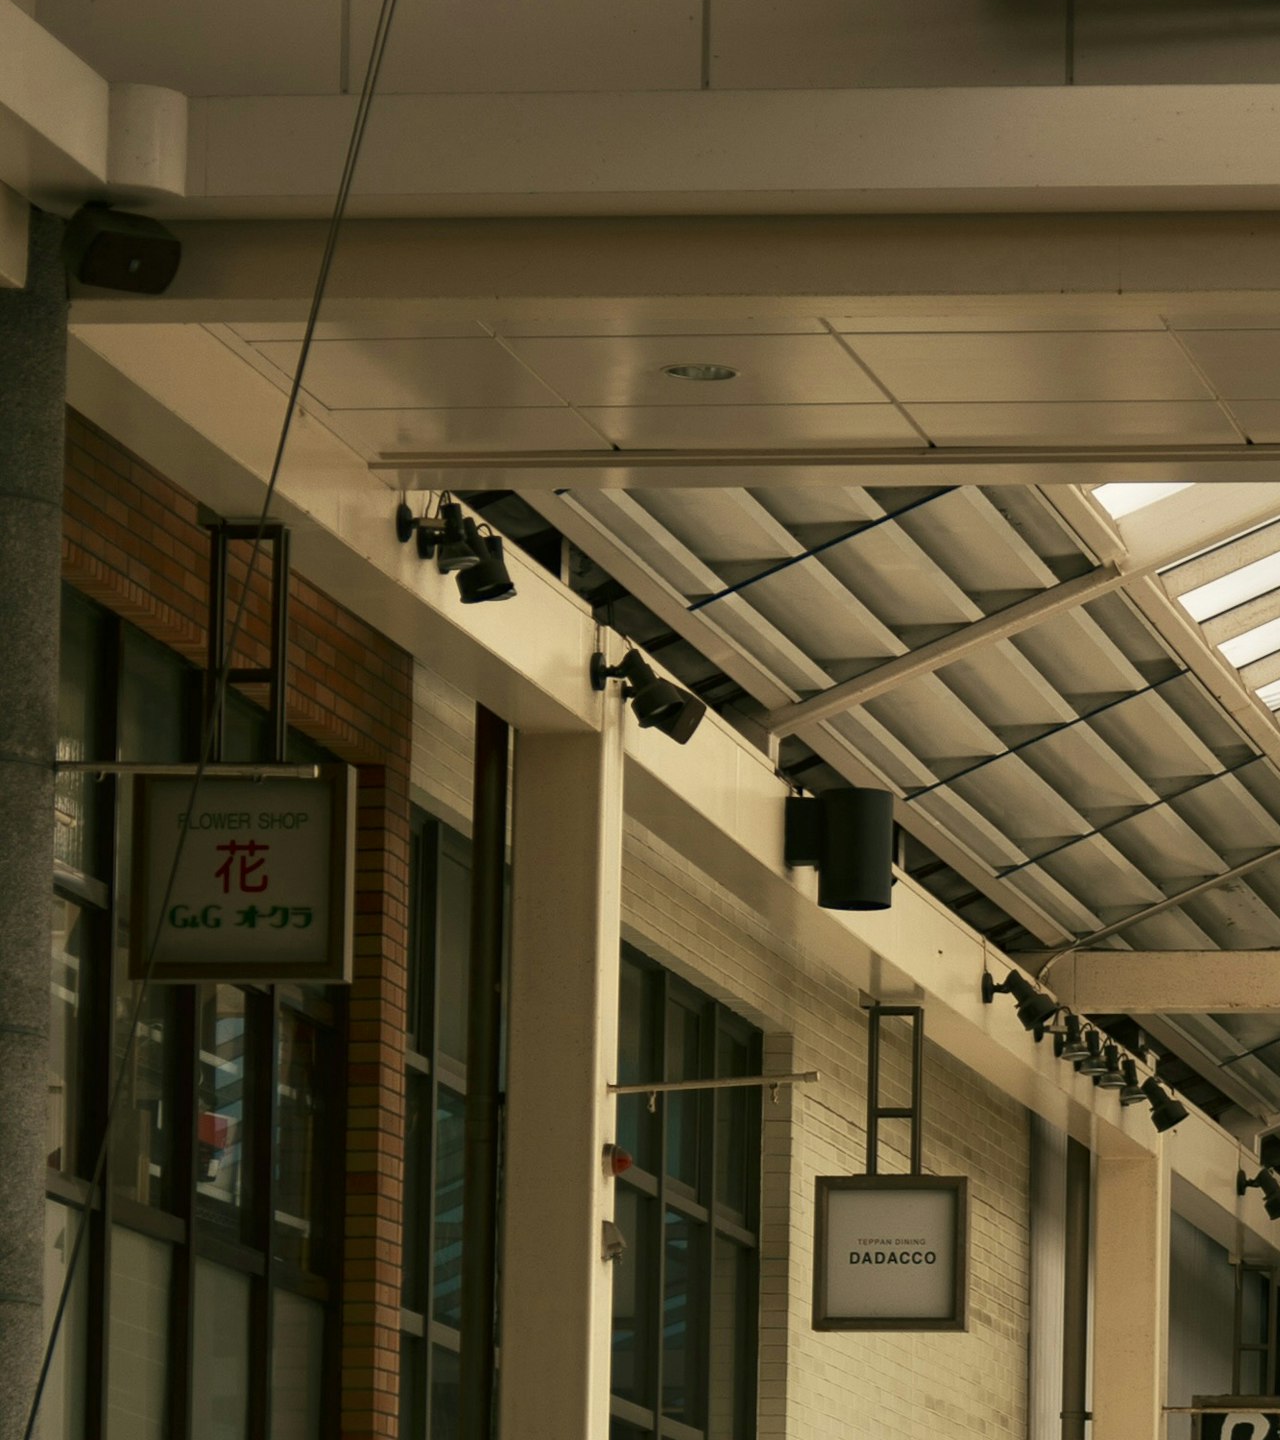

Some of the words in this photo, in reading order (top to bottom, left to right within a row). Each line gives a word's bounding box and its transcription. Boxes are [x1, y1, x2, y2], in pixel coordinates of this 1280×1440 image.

[177, 812, 251, 830] FLOWER
[257, 812, 309, 830] SHOP
[214, 839, 270, 894] 花
[234, 904, 313, 929] オークラ
[857, 1238, 892, 1246] TEPPAN
[894, 1238, 926, 1246] DINING
[849, 1251, 937, 1265] DADACCO
